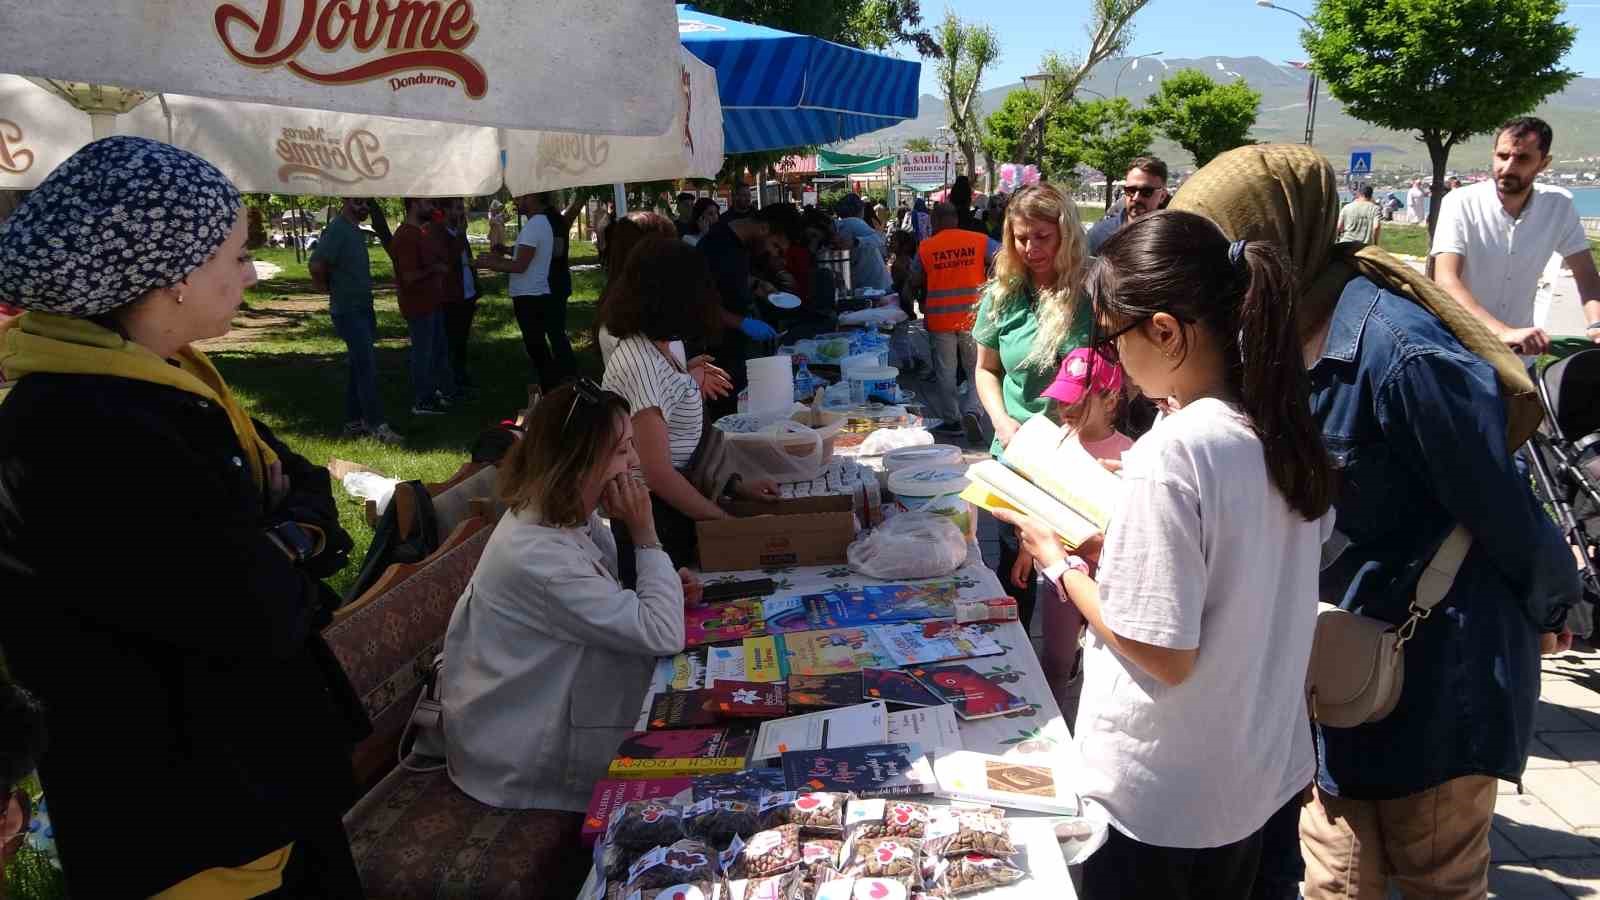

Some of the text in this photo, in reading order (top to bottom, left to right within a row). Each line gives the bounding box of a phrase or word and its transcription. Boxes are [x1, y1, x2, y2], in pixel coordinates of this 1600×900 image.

[390, 73, 457, 92] Dondurma
[932, 247, 976, 262] TATVAN
[687, 758, 738, 768] ERICH
